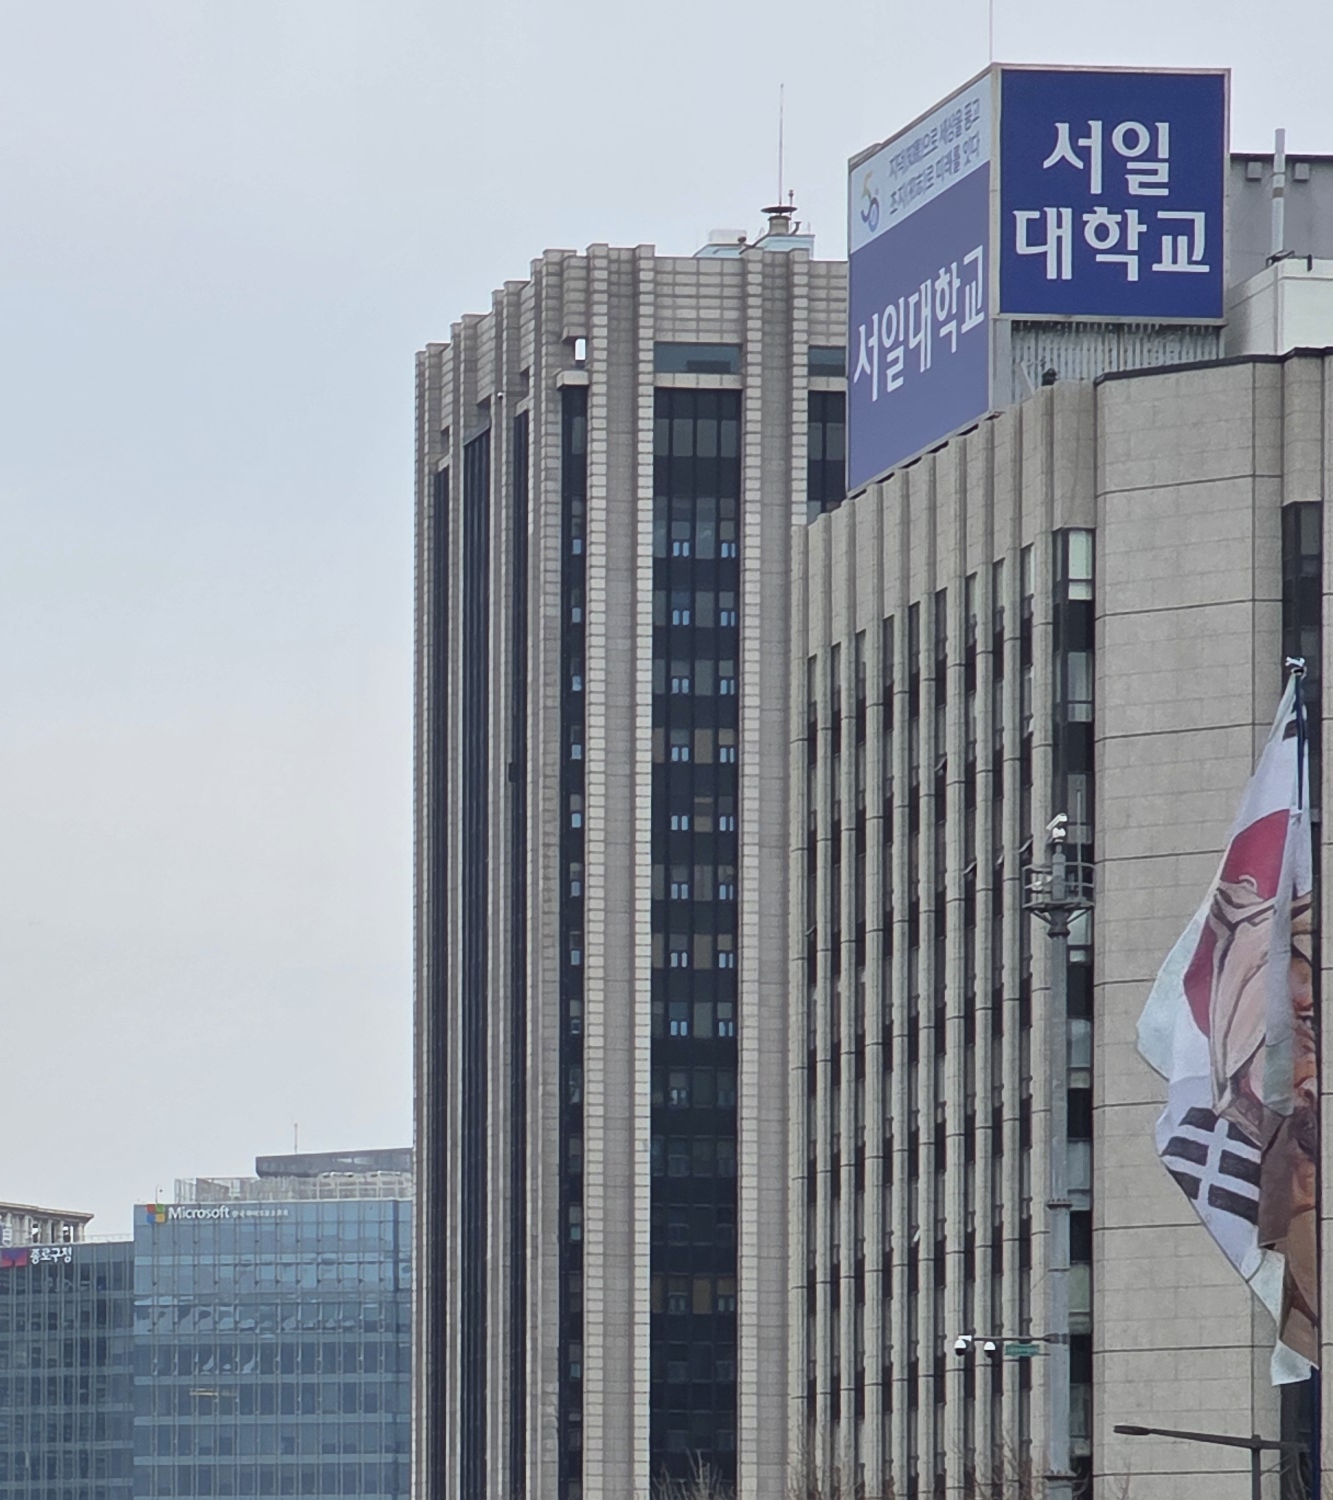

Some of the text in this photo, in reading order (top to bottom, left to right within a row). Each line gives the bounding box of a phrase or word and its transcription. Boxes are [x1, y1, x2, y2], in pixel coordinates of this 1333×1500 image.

[1043, 120, 1170, 196] 서일
[1012, 206, 1210, 281] 대학교
[853, 244, 984, 401] 서일대학교
[168, 1205, 230, 1220] Microsoft
[31, 1246, 73, 1264] 종로구청
